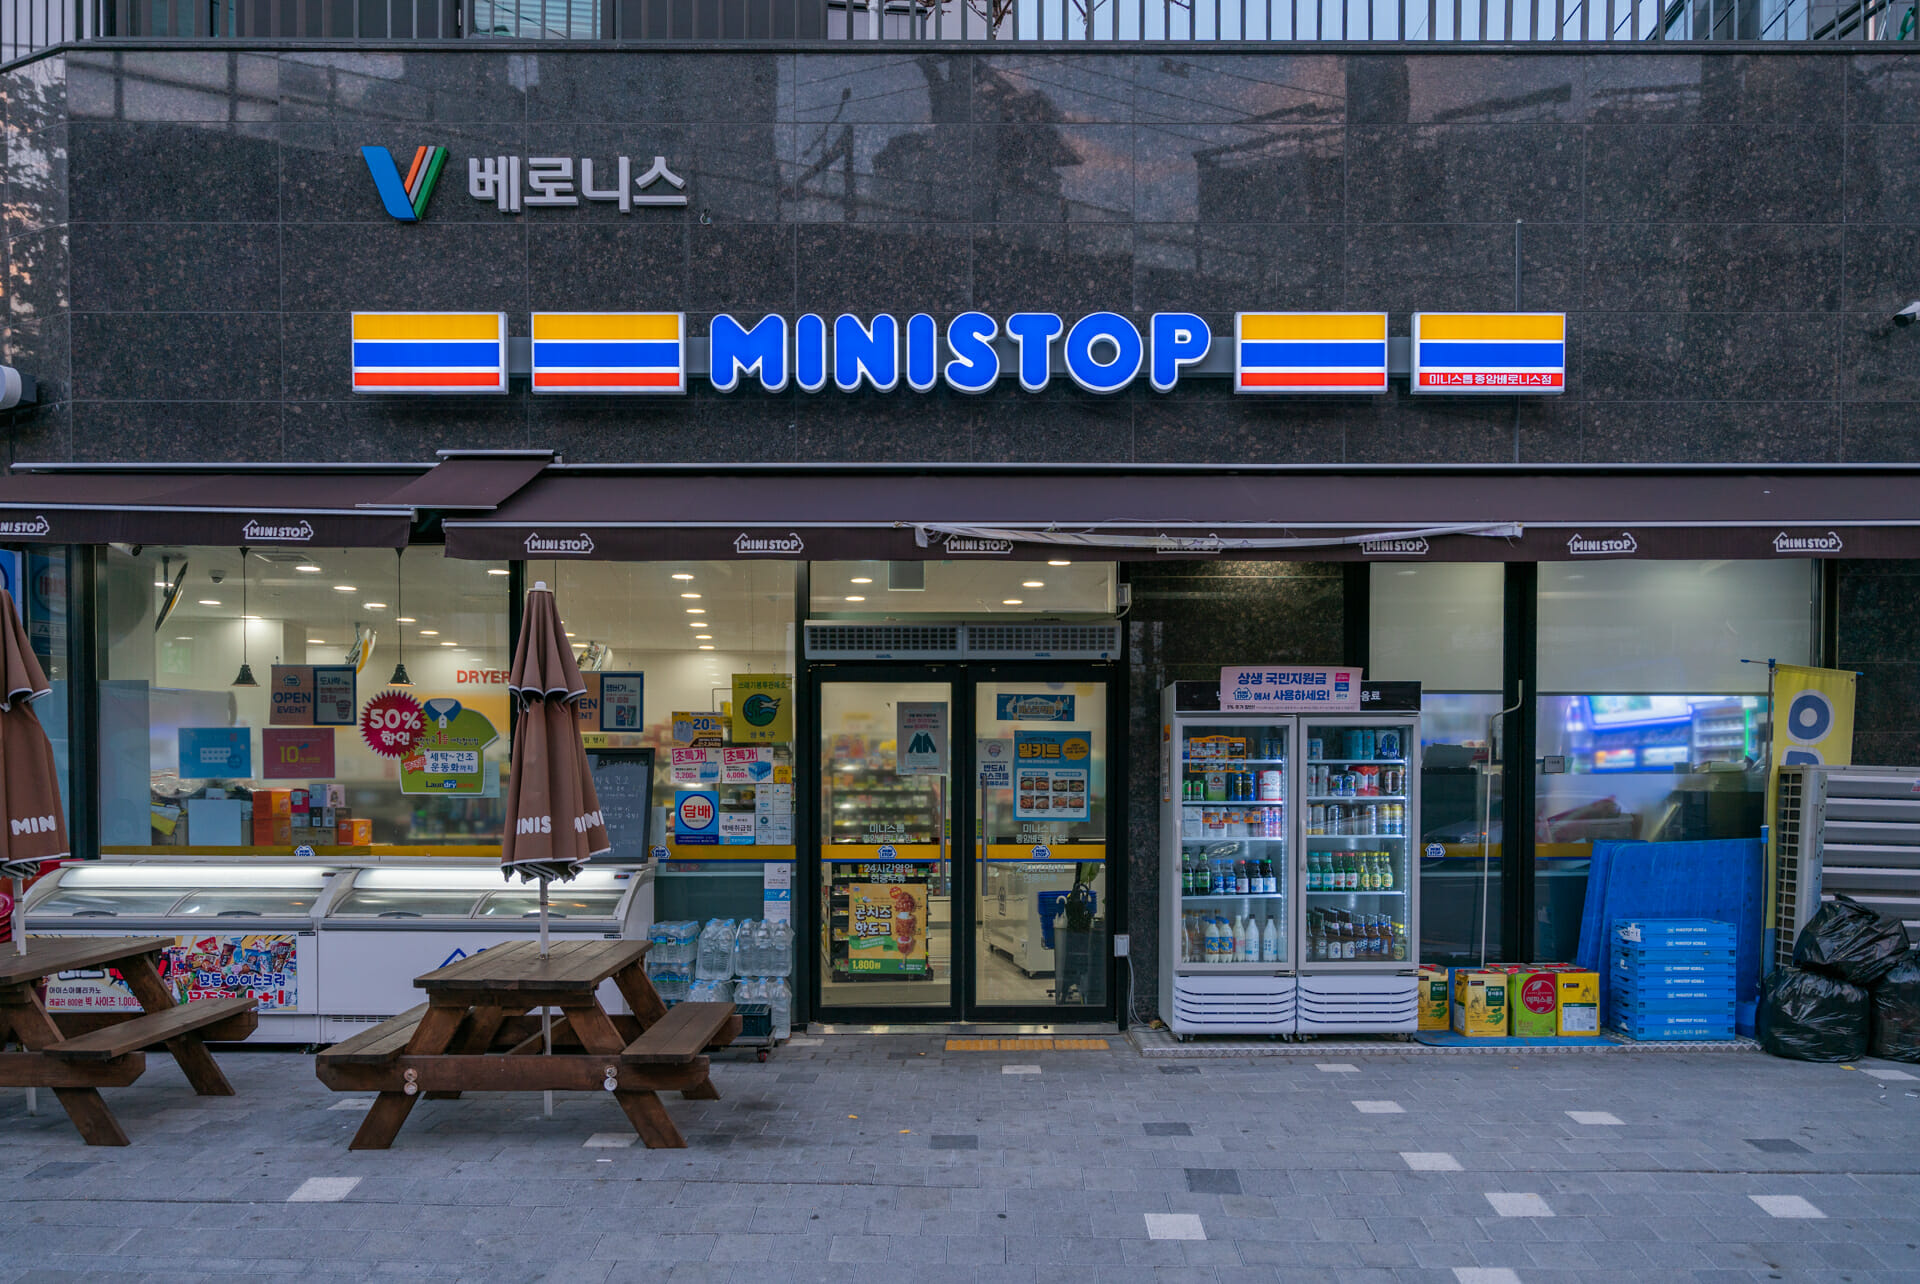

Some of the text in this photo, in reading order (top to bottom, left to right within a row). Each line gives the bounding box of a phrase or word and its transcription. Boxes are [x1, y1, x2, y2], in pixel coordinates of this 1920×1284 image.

[468, 156, 688, 213] 베로니스
[709, 310, 1212, 394] MINISTOP
[1429, 374, 1473, 384] 미니스톱
[1238, 672, 1263, 685] 상생
[1265, 672, 1327, 685] 국민지원금
[273, 692, 311, 704] OPEN
[1254, 689, 1330, 701] 에서 사용하세요!
[277, 706, 308, 714] EVENT
[369, 708, 422, 730] 50%
[380, 731, 411, 746] 할인
[279, 746, 299, 764] 10
[674, 749, 705, 762] 초특가
[726, 749, 756, 762] 초특가
[683, 804, 711, 819] 담배
[10, 815, 56, 836] MIN
[864, 863, 913, 873] 24시간영업
[855, 904, 892, 920] 콘치즈
[855, 921, 892, 937] 핫도그
[852, 960, 881, 970] 1,800원
[200, 973, 286, 987] 모든 아이스크림
[49, 986, 102, 994] 아이스아메리카노
[85, 996, 93, 1006] 빅
[95, 996, 116, 1006] 사이즈
